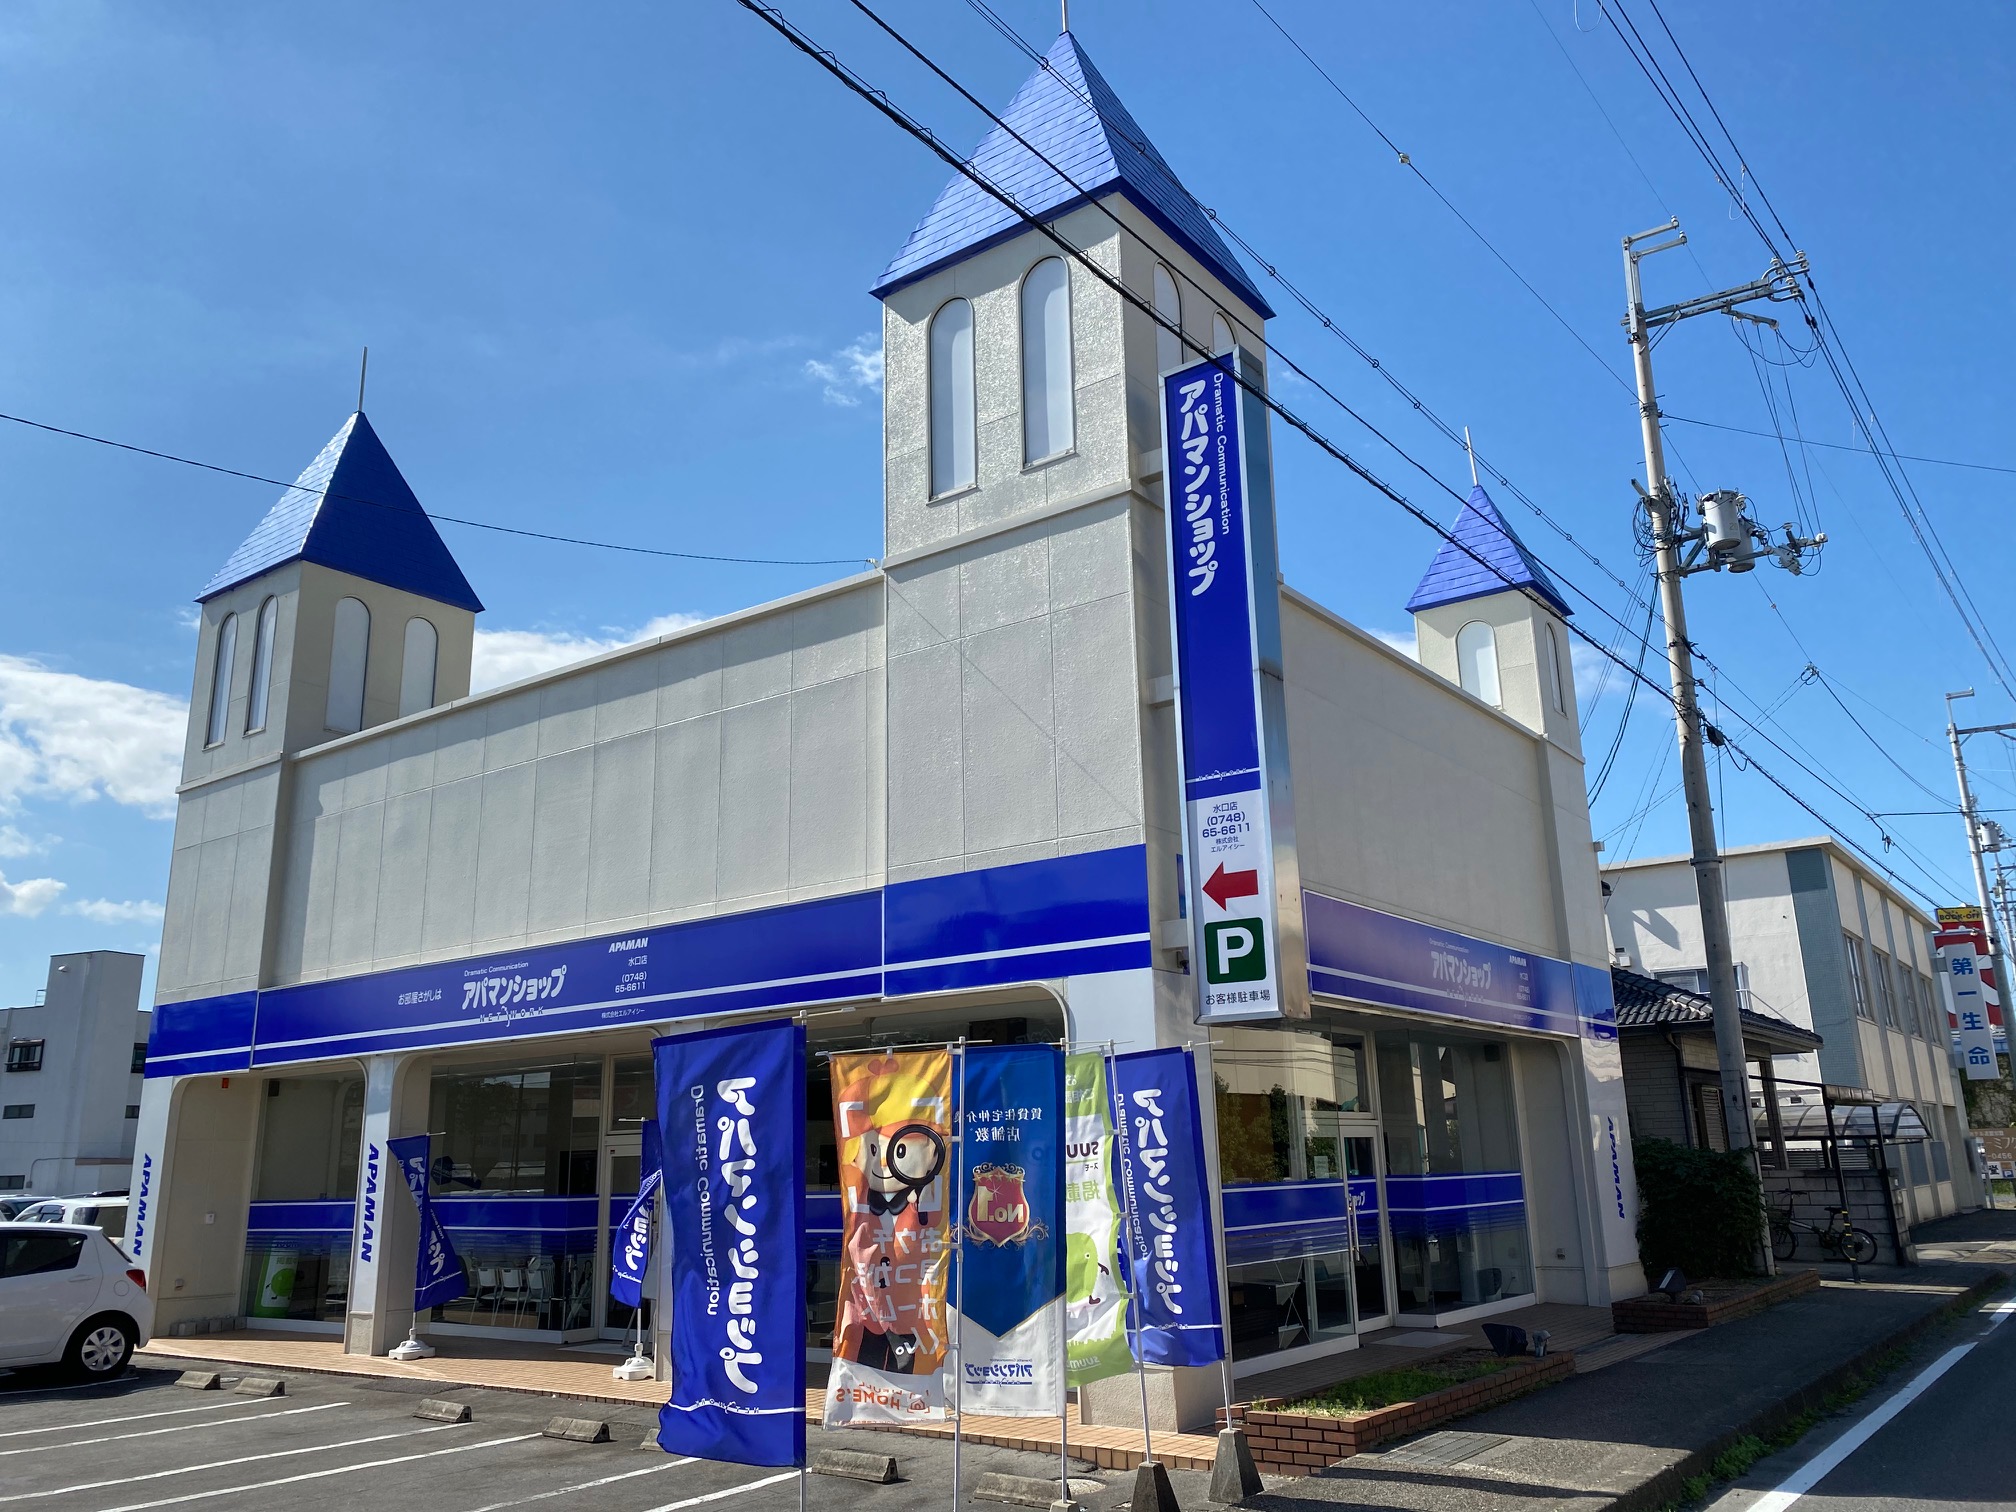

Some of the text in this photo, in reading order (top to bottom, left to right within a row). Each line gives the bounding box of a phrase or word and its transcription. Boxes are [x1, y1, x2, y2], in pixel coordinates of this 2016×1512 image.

[1213, 372, 1230, 535] Dramatic Communication
[1179, 379, 1218, 596] アパマンショップ
[1212, 801, 1238, 813] 水口店
[1207, 811, 1246, 827] (0748)
[1202, 822, 1250, 838] 65-6611
[1210, 843, 1245, 853] エルアイシー
[1215, 836, 1239, 845] 株式会社
[608, 937, 648, 953] APAMAN
[1217, 926, 1254, 975] P
[464, 961, 529, 977] Dramatic Communication
[628, 955, 648, 967] 水口店
[622, 971, 647, 983] (0748)
[1431, 950, 1492, 990] アパマンショップ
[462, 964, 567, 1010] アパマンショップ
[615, 981, 646, 993] 65-6611
[398, 988, 442, 1005] お部屋さがしは
[1205, 989, 1271, 1005] お客様駐車場
[1952, 957, 1990, 1065] 第一生命
[1606, 1116, 1625, 1219] APAMAN
[133, 1153, 153, 1256] APAMAN
[361, 1143, 381, 1263] APAMAN
